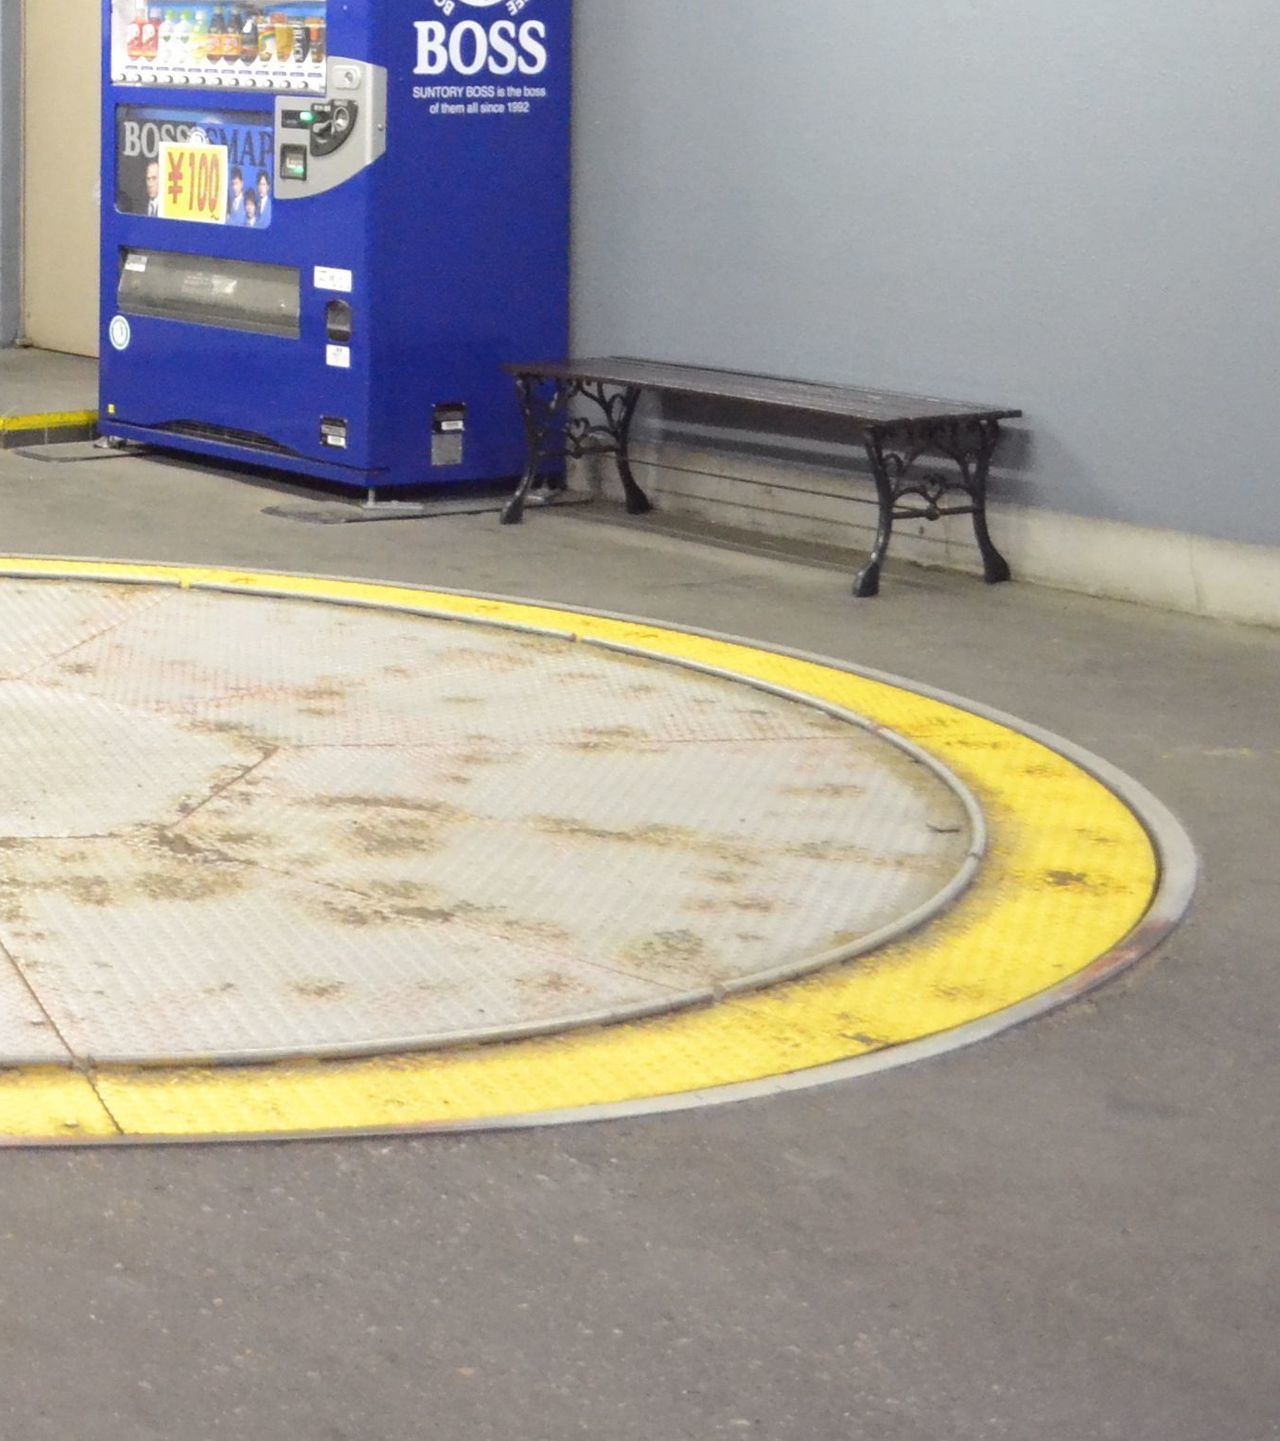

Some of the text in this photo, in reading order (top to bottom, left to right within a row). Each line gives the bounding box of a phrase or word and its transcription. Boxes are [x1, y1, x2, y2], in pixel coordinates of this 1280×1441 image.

[412, 19, 548, 76] BOSS
[412, 85, 546, 99] SUNTORY BOSS is the boss
[429, 101, 530, 114] of them all since 1992
